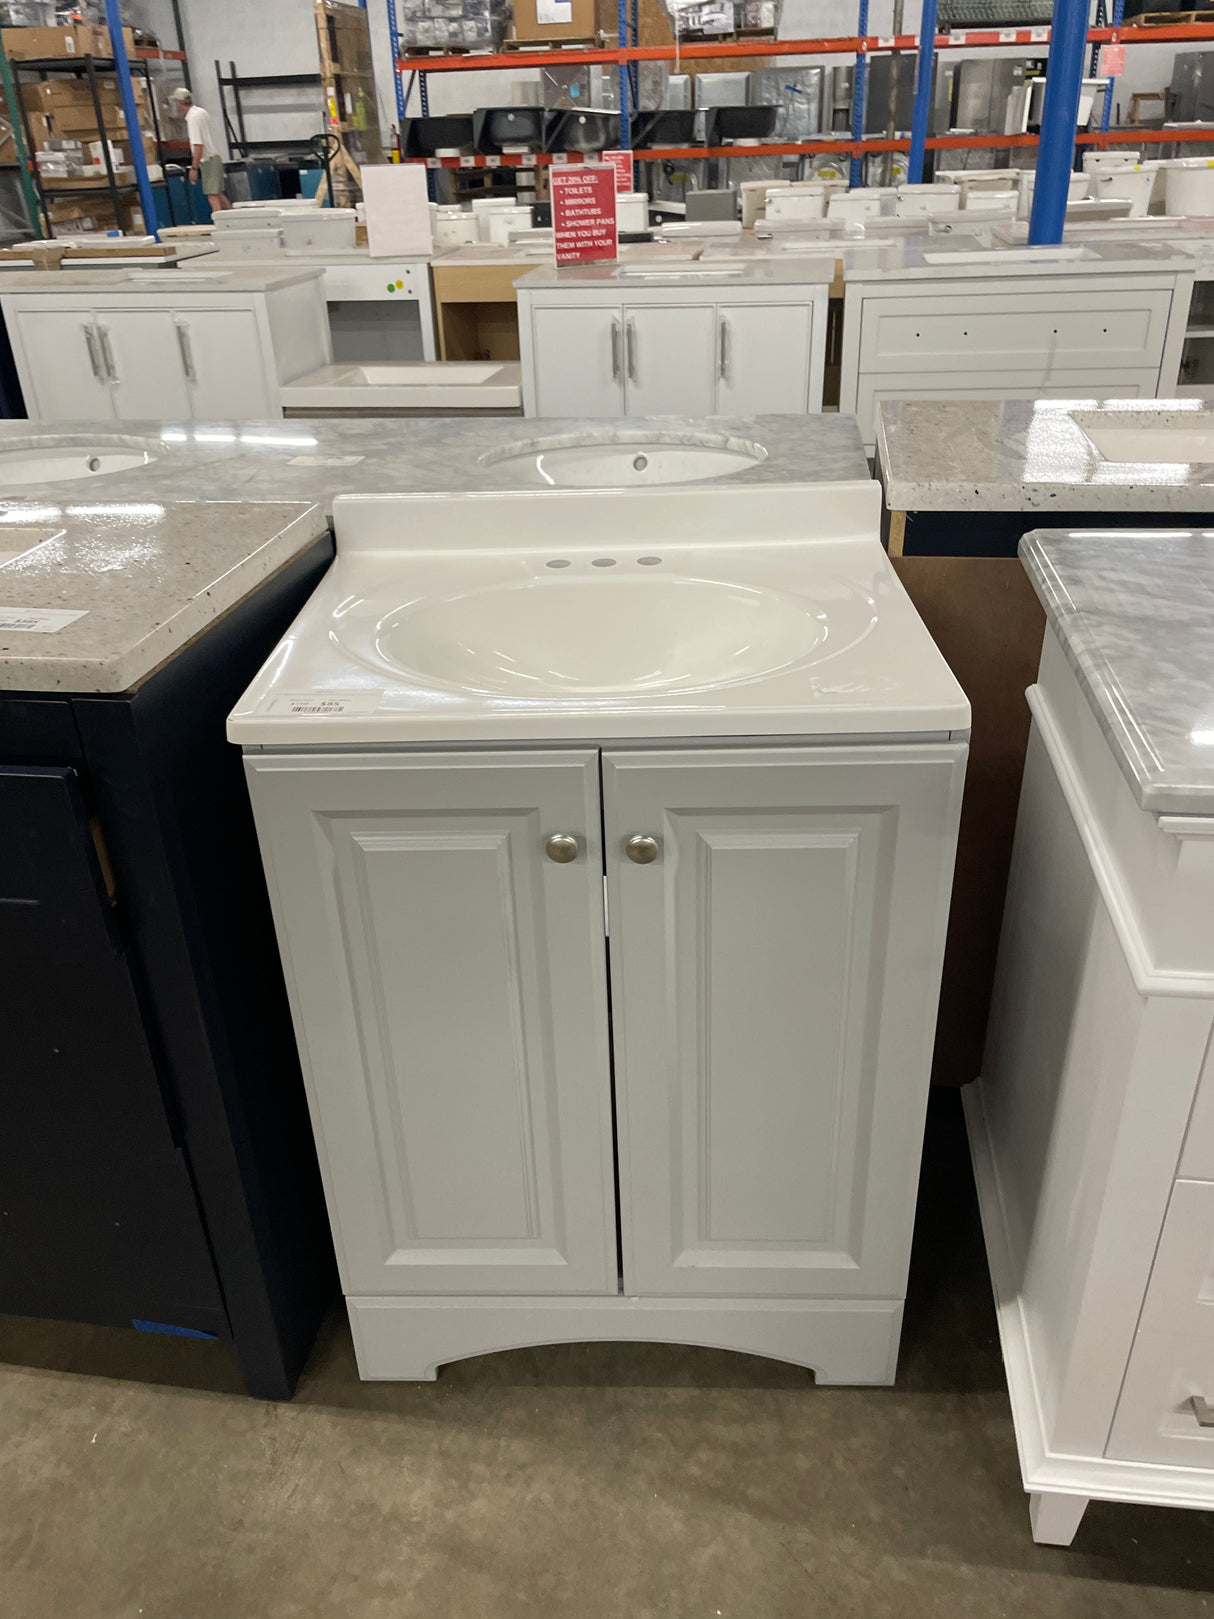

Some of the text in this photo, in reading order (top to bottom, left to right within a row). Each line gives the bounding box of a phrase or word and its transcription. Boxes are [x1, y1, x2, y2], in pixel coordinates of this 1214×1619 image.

[564, 186, 592, 194] TOILETS
[564, 197, 596, 205] MIRRORS
[566, 208, 602, 216] BATHTUBS
[566, 219, 596, 228] SHOWER
[594, 239, 612, 247] YOUR
